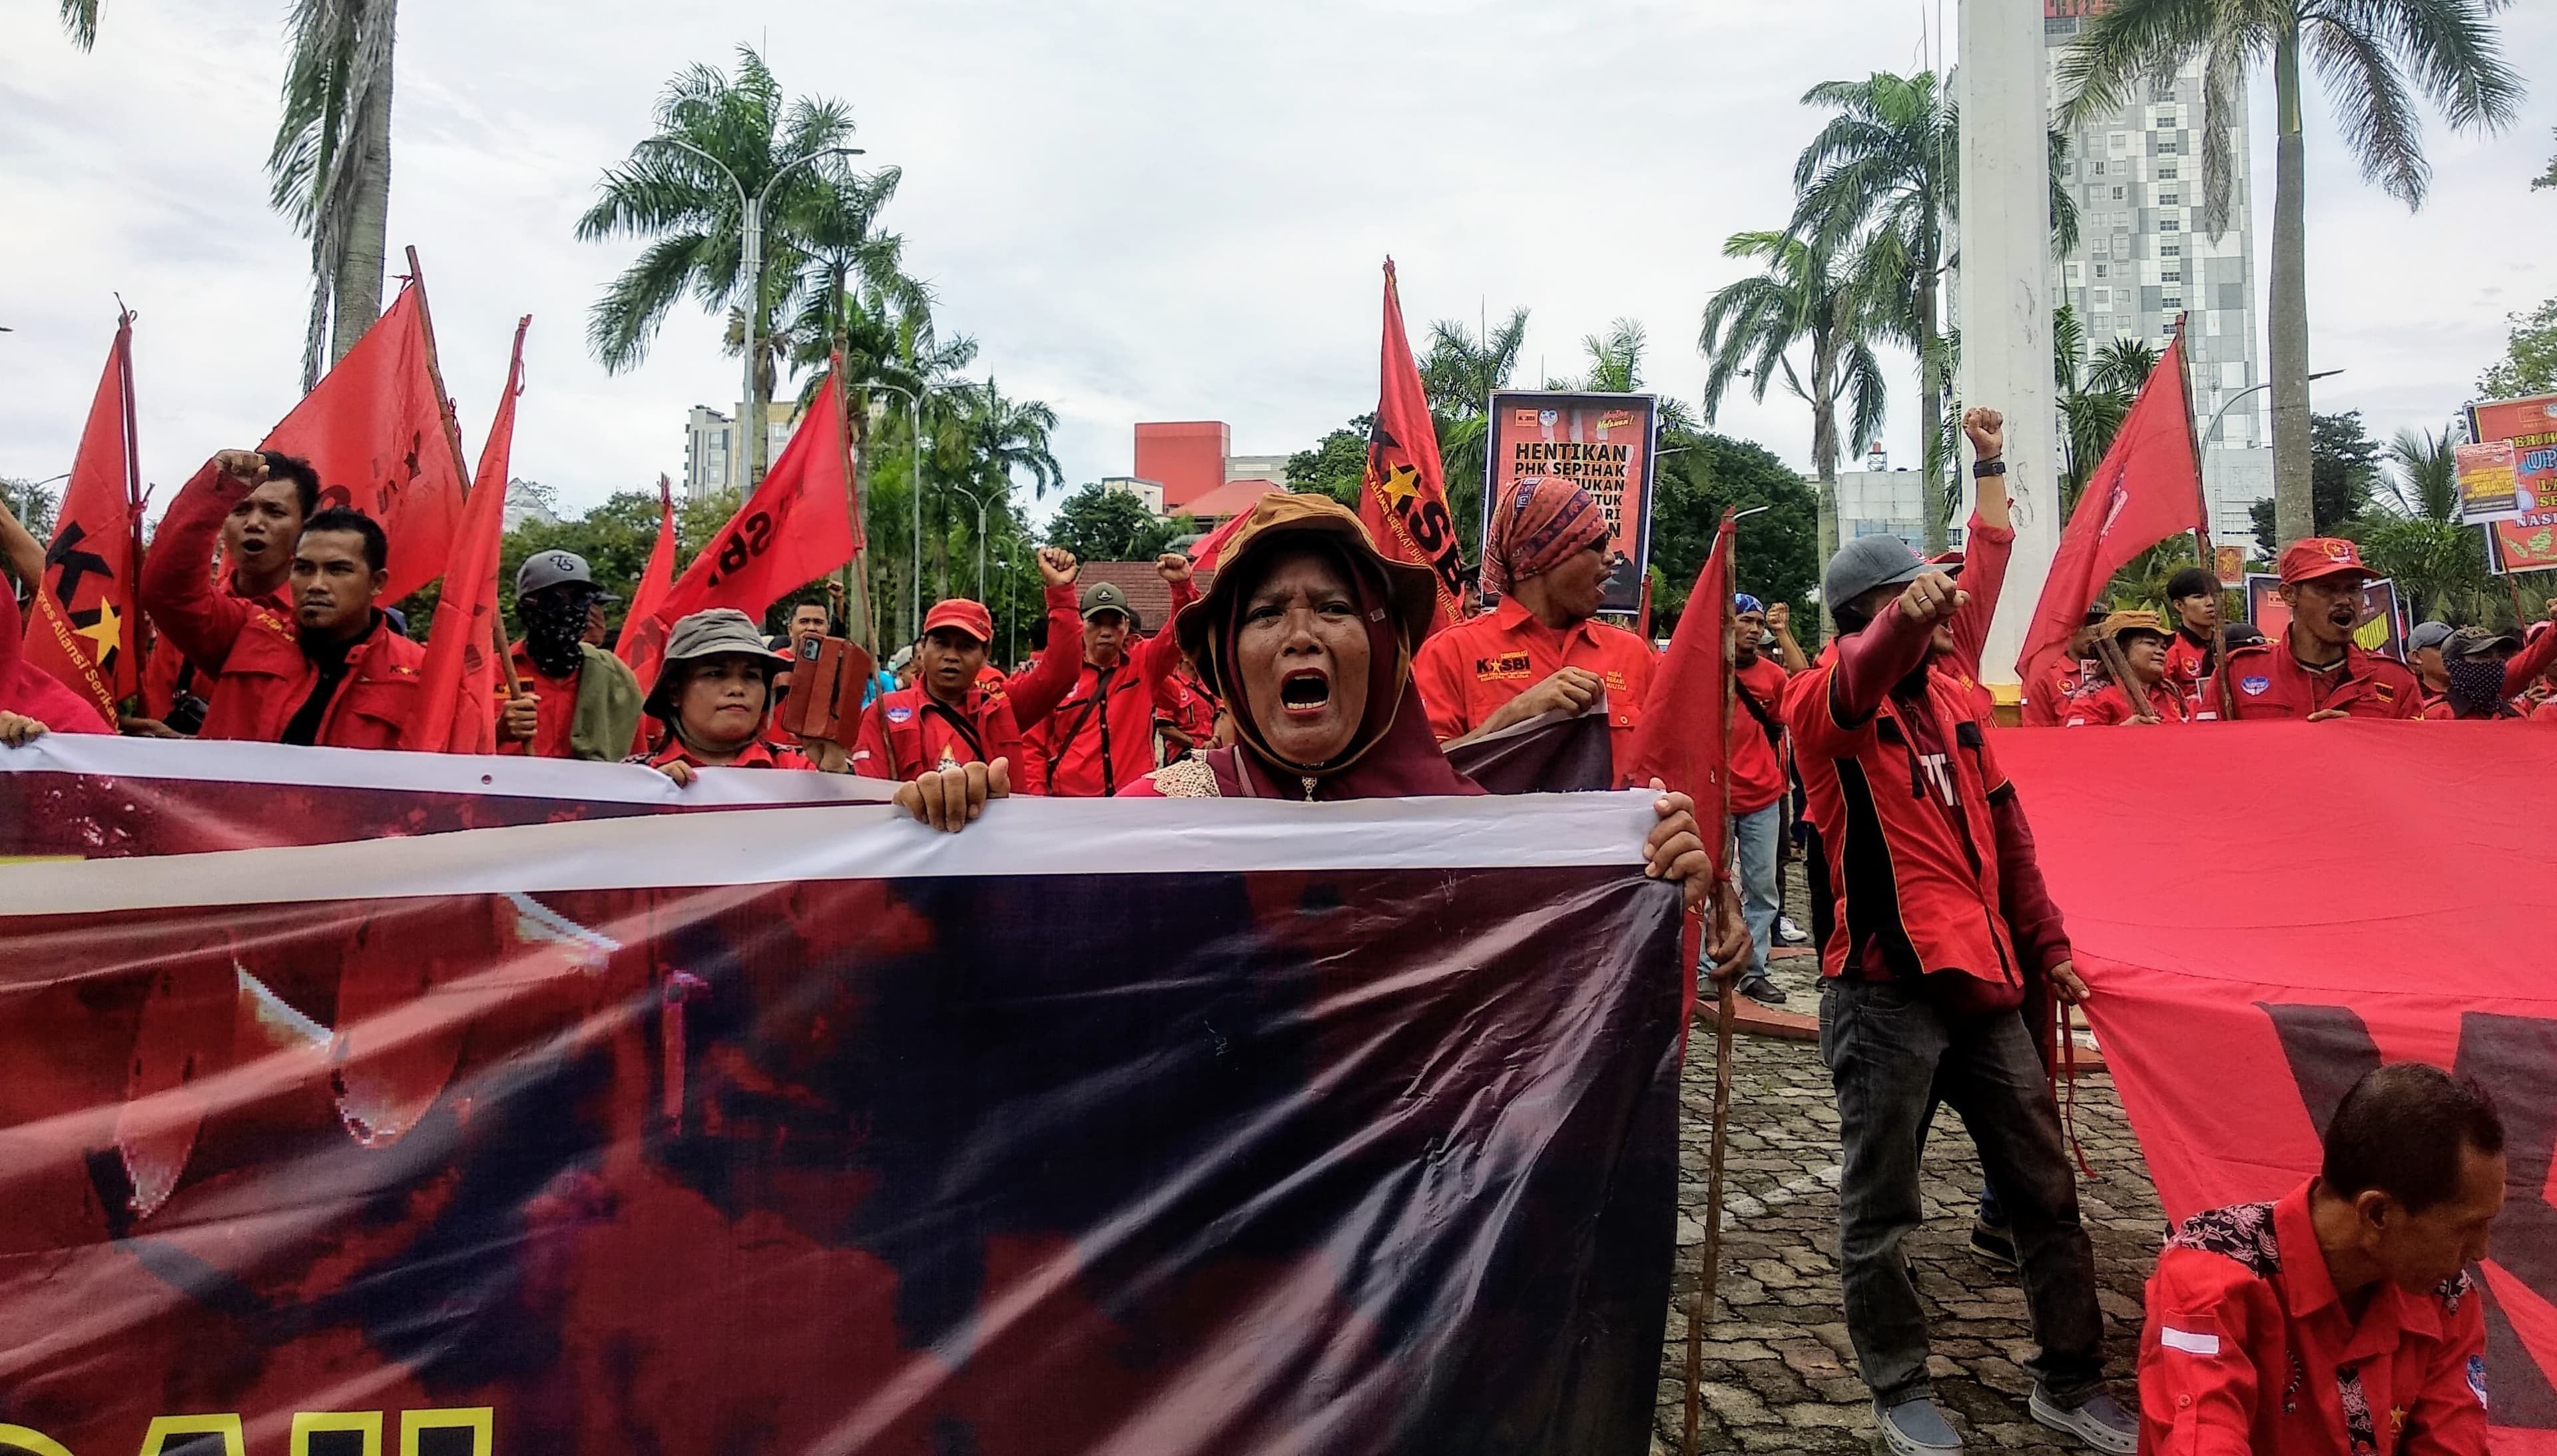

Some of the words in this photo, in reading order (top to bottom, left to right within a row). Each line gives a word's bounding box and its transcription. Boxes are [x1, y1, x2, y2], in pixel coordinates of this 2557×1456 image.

[1516, 443, 1627, 462] HENTIKAN
[1515, 462, 1547, 475] PHK
[1553, 462, 1625, 477] SEPIHAK
[52, 620, 91, 670] Aliansi
